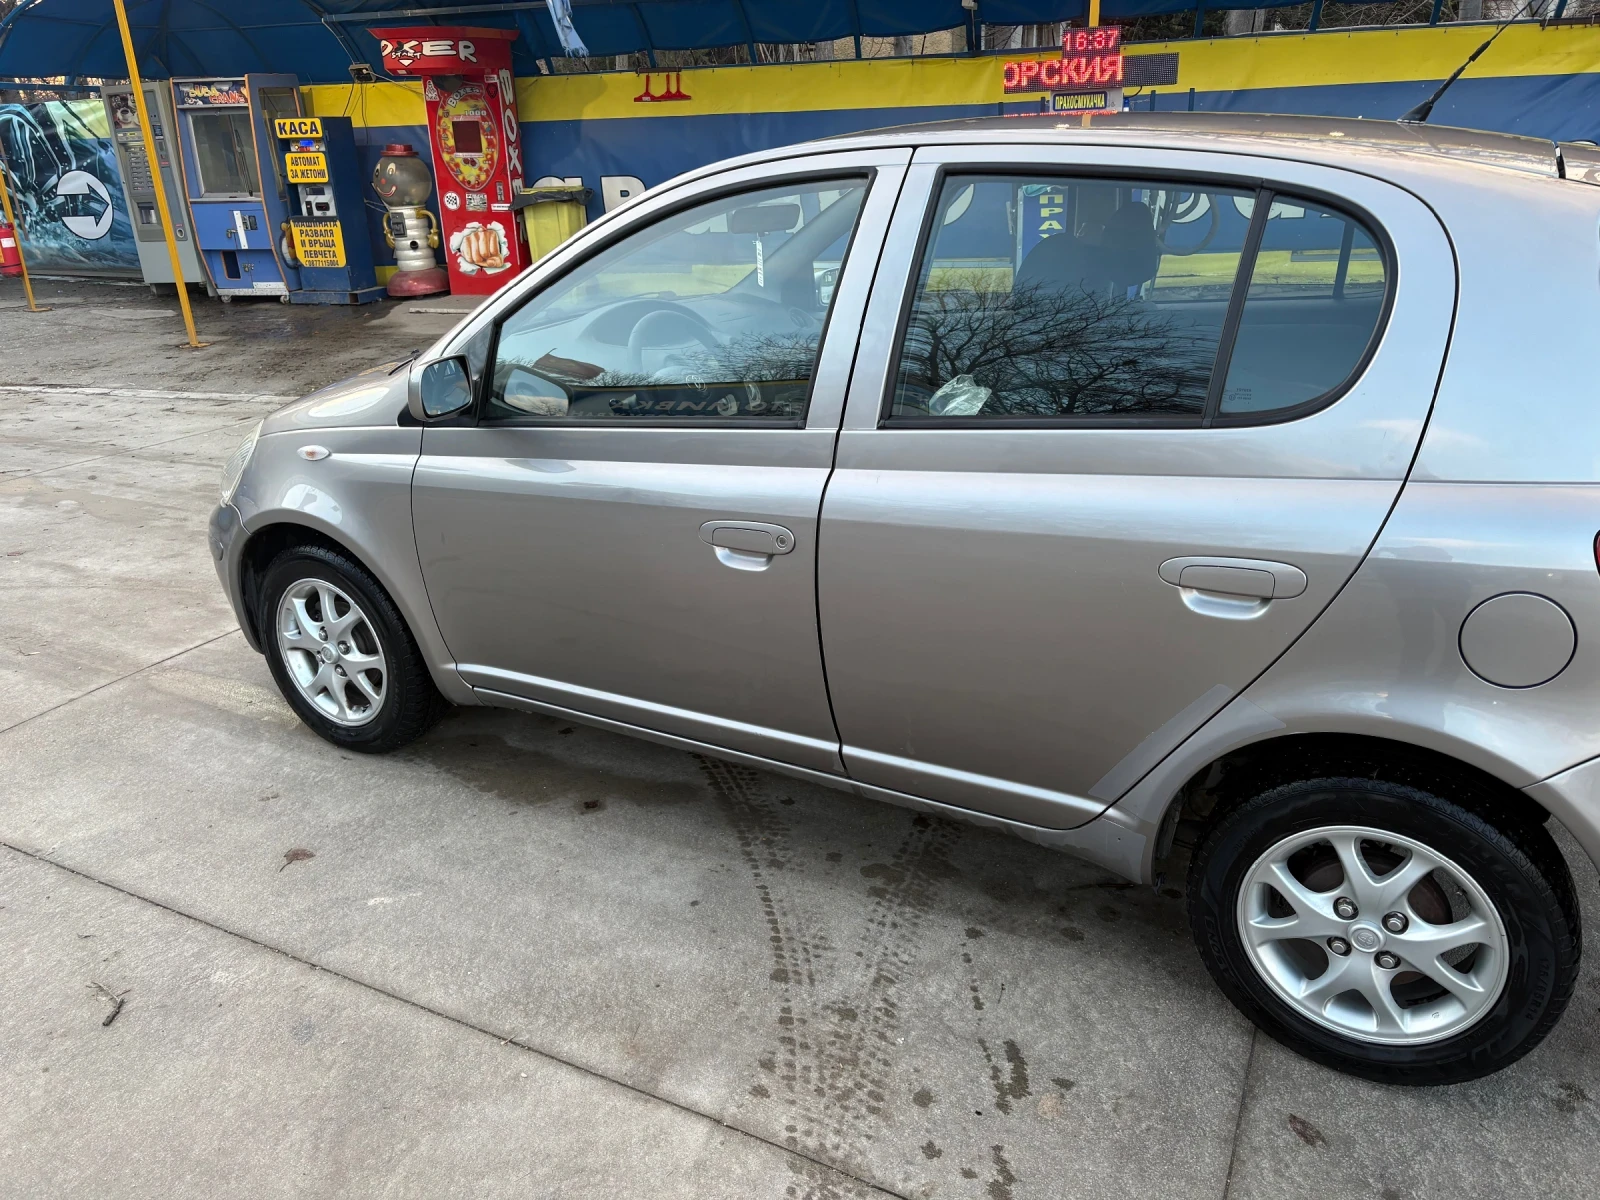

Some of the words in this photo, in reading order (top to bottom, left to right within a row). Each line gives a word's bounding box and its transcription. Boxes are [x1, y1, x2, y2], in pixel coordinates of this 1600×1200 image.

[1055, 94, 1105, 110] ПРАХОСМУКАЧКА
[278, 121, 320, 136] КАСА
[290, 156, 320, 167] АВТОМАТ
[290, 168, 299, 179] ЗА
[300, 168, 327, 179] ЖЕТОНИ
[299, 229, 335, 238] РАЗВАЛЯ
[300, 239, 307, 248] И
[308, 239, 336, 248] ВРЪЩА
[303, 250, 337, 258] ЛЕВЧЕТА
